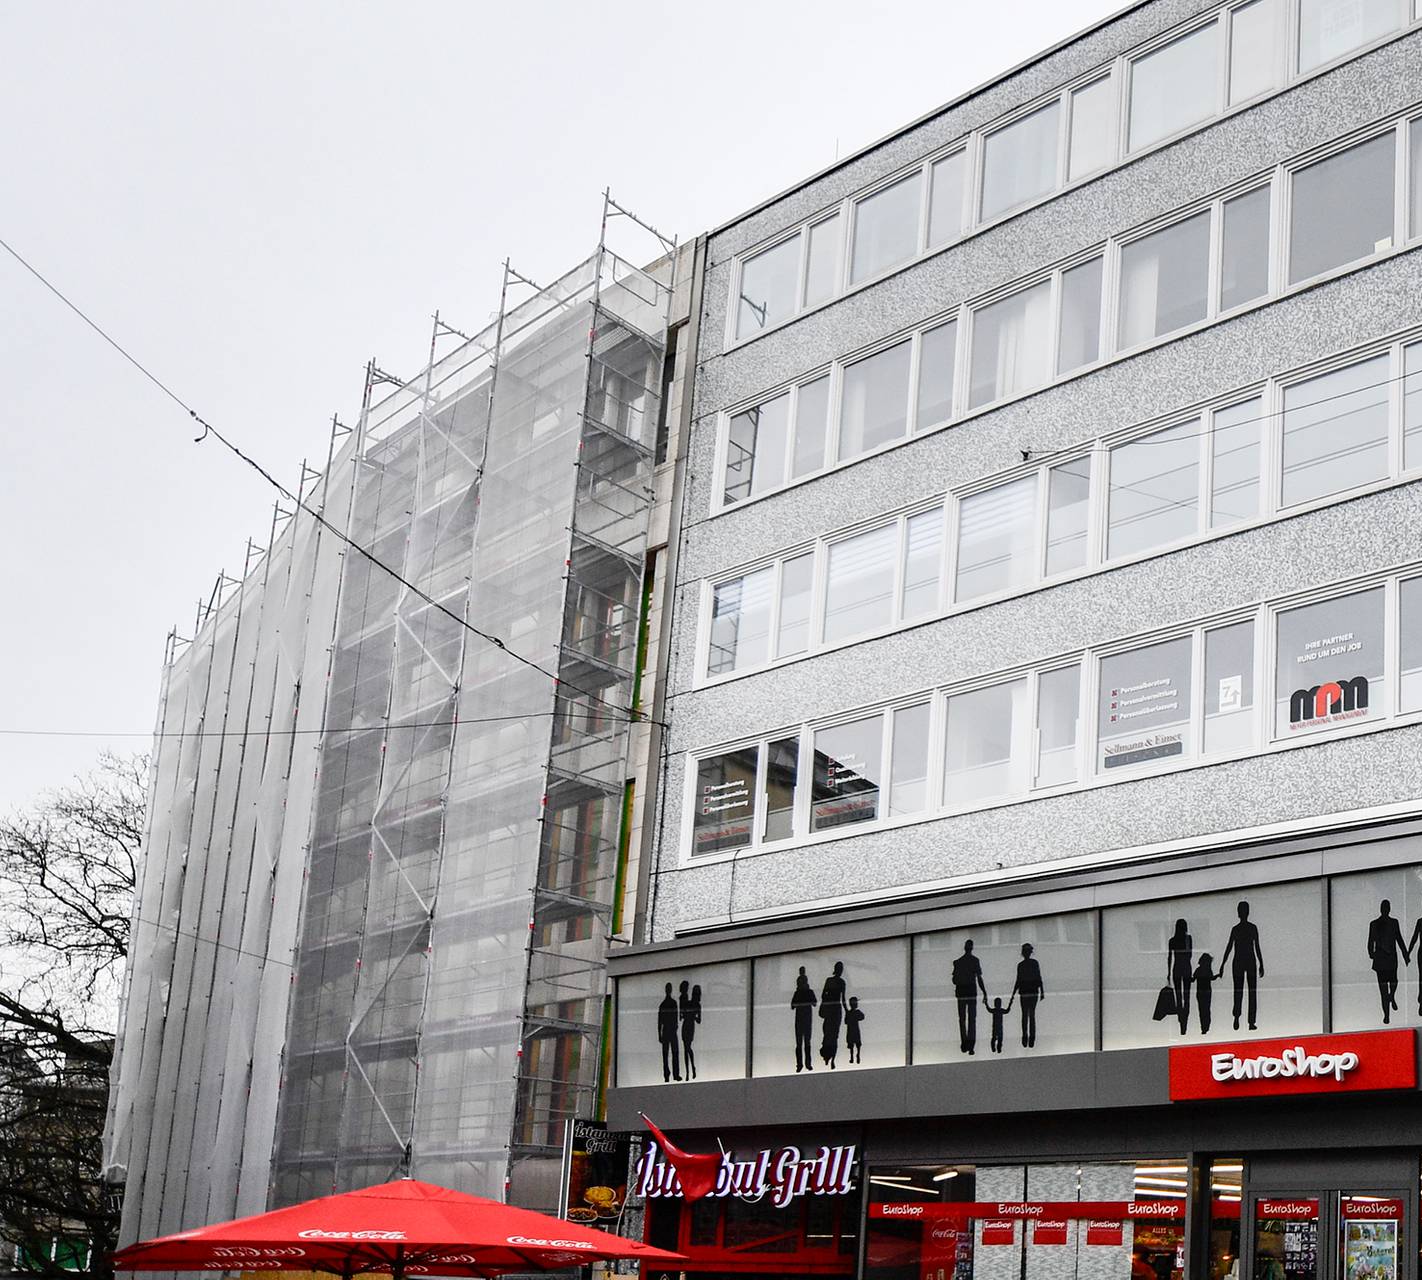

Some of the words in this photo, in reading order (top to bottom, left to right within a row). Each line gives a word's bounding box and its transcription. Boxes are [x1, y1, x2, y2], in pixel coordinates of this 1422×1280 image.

[1322, 633, 1354, 646] PARTNER
[1297, 652, 1317, 663] RUND
[1318, 649, 1329, 658] UM
[1330, 645, 1346, 656] DEN
[1347, 642, 1362, 651] JOB
[1210, 1046, 1359, 1082] EuroShop
[769, 1145, 857, 1208] Grill
[882, 1204, 924, 1216] EuroShop
[998, 1203, 1043, 1215] EuroShop
[1128, 1202, 1179, 1216] EuroShop
[1263, 1203, 1312, 1216] EuroShop
[1346, 1203, 1397, 1216] EuroShop
[297, 1229, 408, 1240] Coca-Cola
[506, 1235, 597, 1250] Coca-Cola
